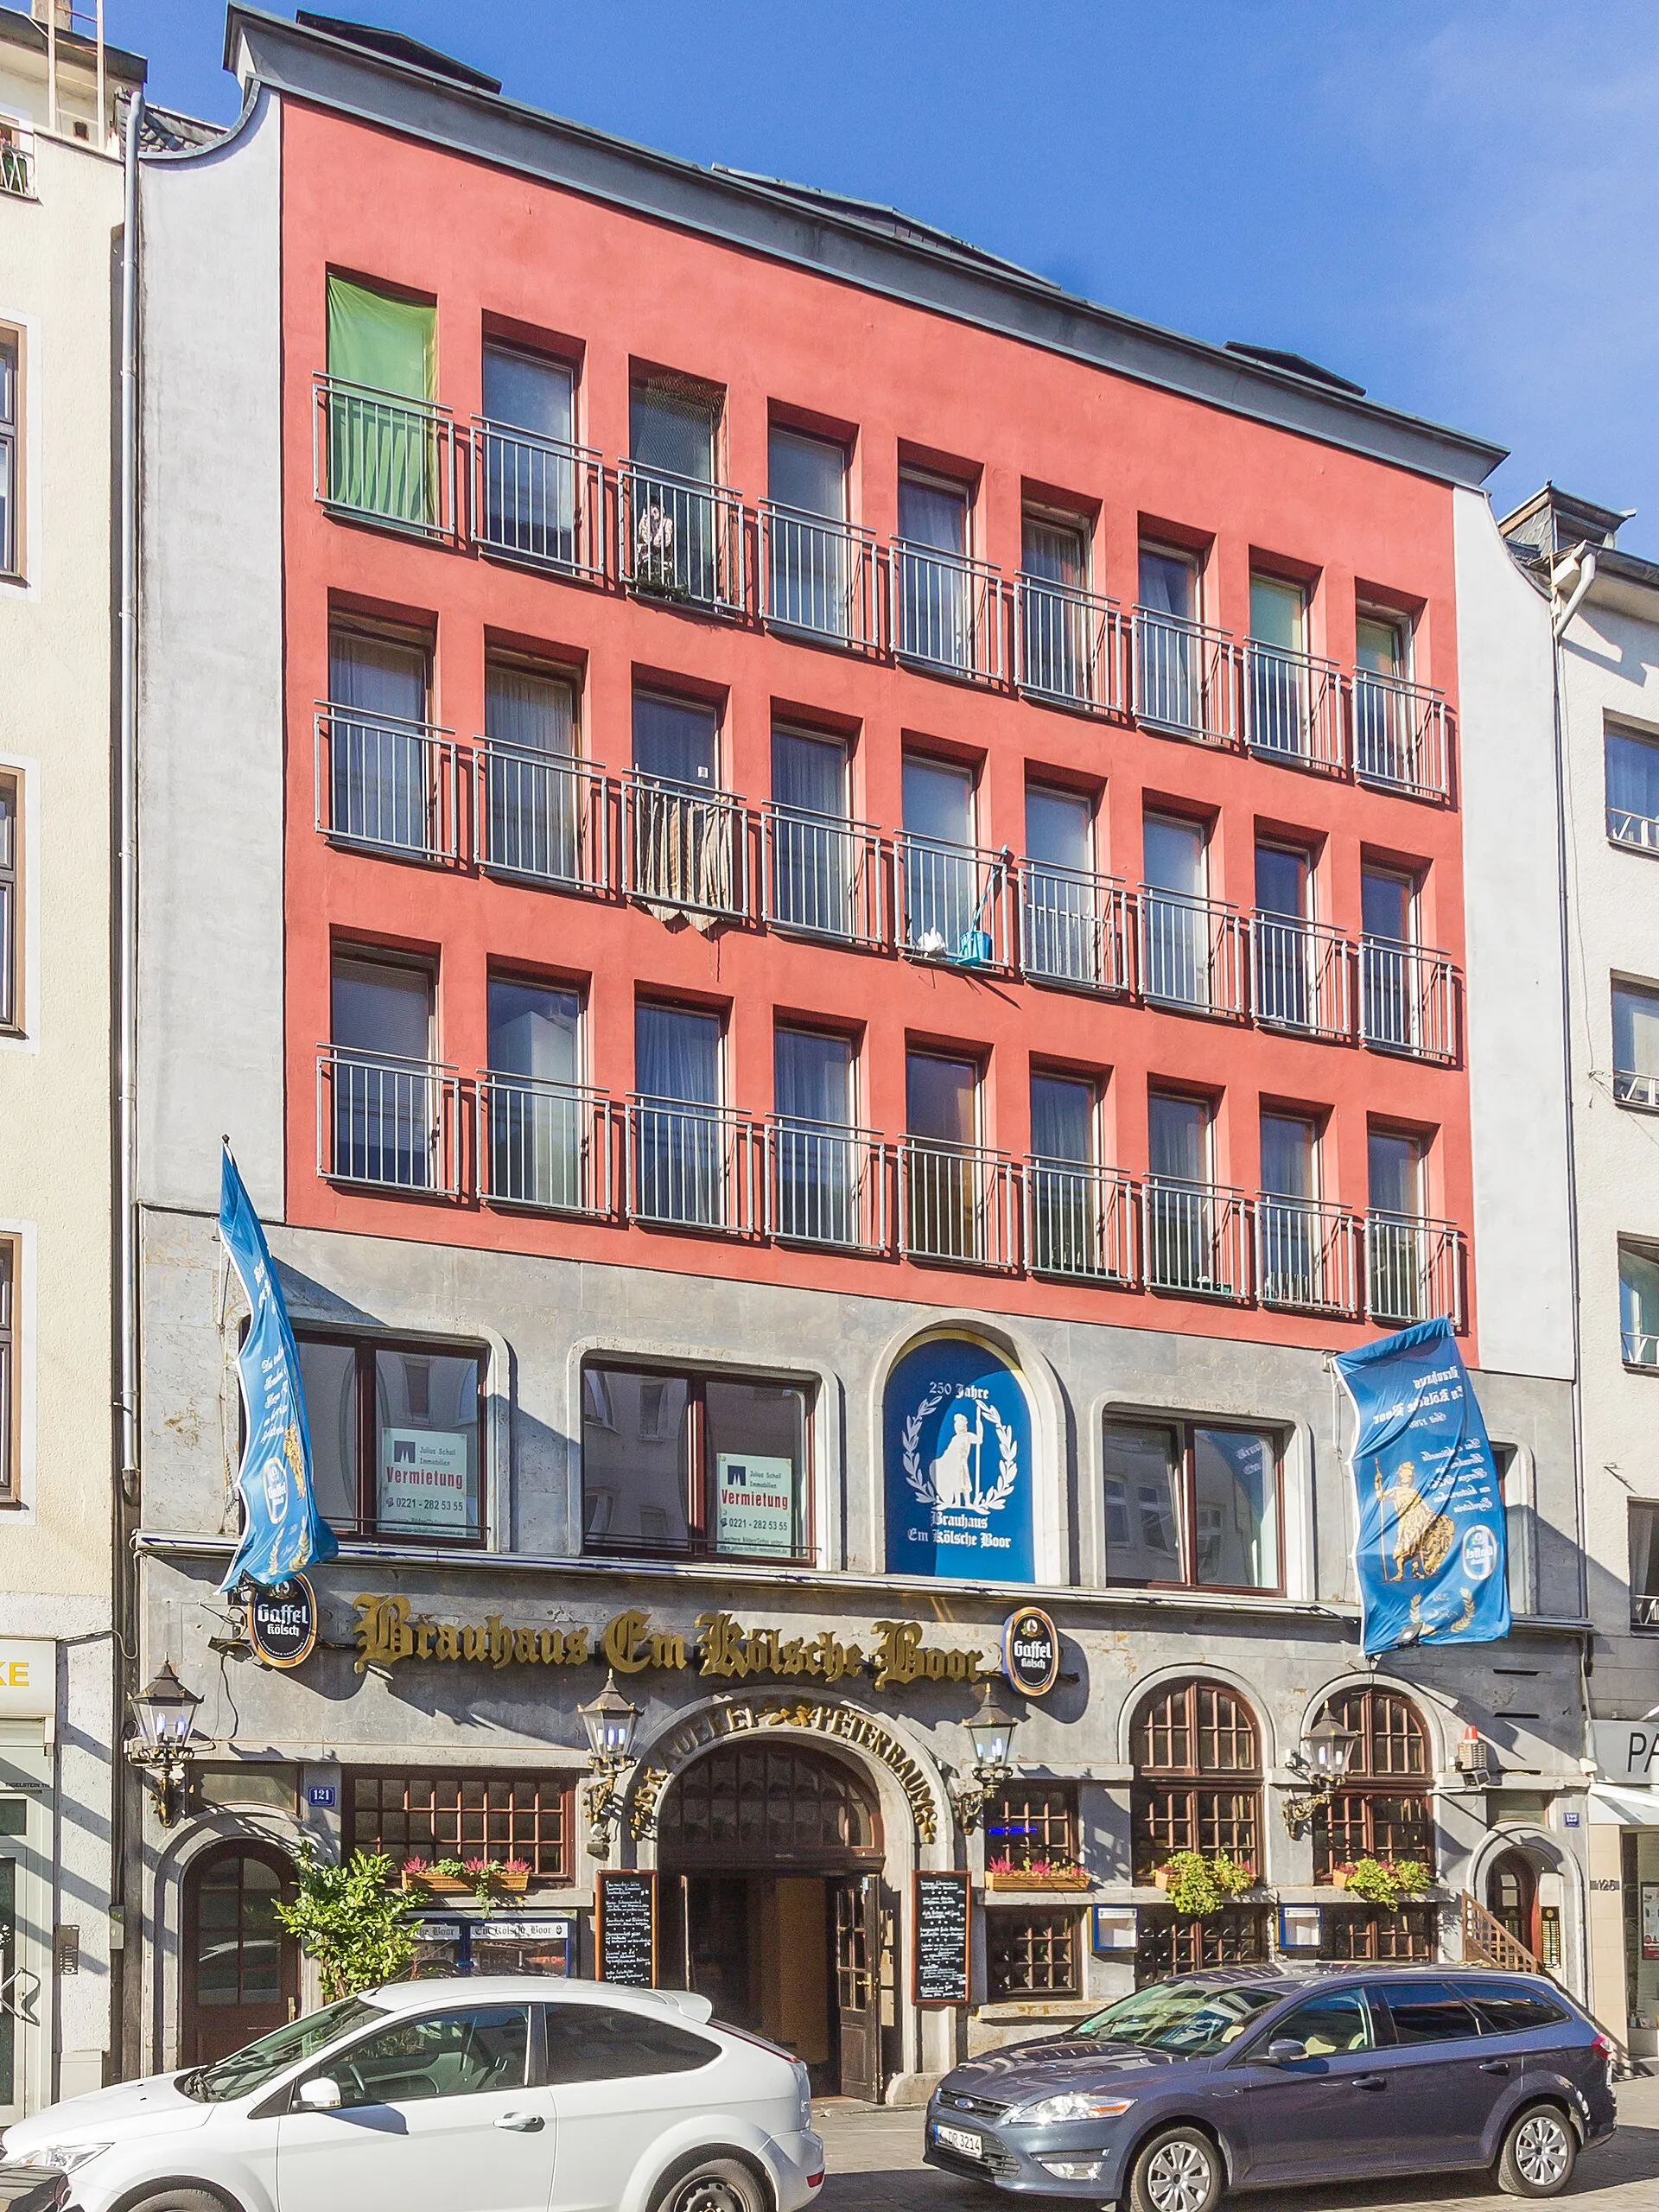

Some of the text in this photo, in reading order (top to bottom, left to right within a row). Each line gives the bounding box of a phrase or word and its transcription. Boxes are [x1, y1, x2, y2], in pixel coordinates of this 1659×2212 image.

[929, 1382, 989, 1400] 250 Jahre
[386, 1466, 463, 1490] Vermietung
[396, 1497, 416, 1508] 0221
[424, 1499, 439, 1510] 282
[442, 1500, 451, 1510] 53
[721, 1489, 788, 1510] Vermietung
[728, 1518, 747, 1529] 0221
[753, 1520, 766, 1530] 282
[769, 1521, 777, 1530] 53
[779, 1522, 788, 1531] 55
[930, 1510, 988, 1529] Brauhaus
[907, 1528, 1012, 1548] Em Kölsche Boor
[257, 1604, 308, 1624] Gaffel
[267, 1624, 300, 1637] Kölsch
[353, 1593, 985, 1692] Brauhaus Em Kölsche Boor
[1014, 1640, 1052, 1659] Gaffel
[1020, 1658, 1046, 1669] Kölsch
[0, 1662, 29, 1687] E
[314, 1789, 329, 1800] 121
[433, 1926, 454, 1936] Boor
[531, 1925, 552, 1935] Boor
[960, 2134, 981, 2151] 3214
